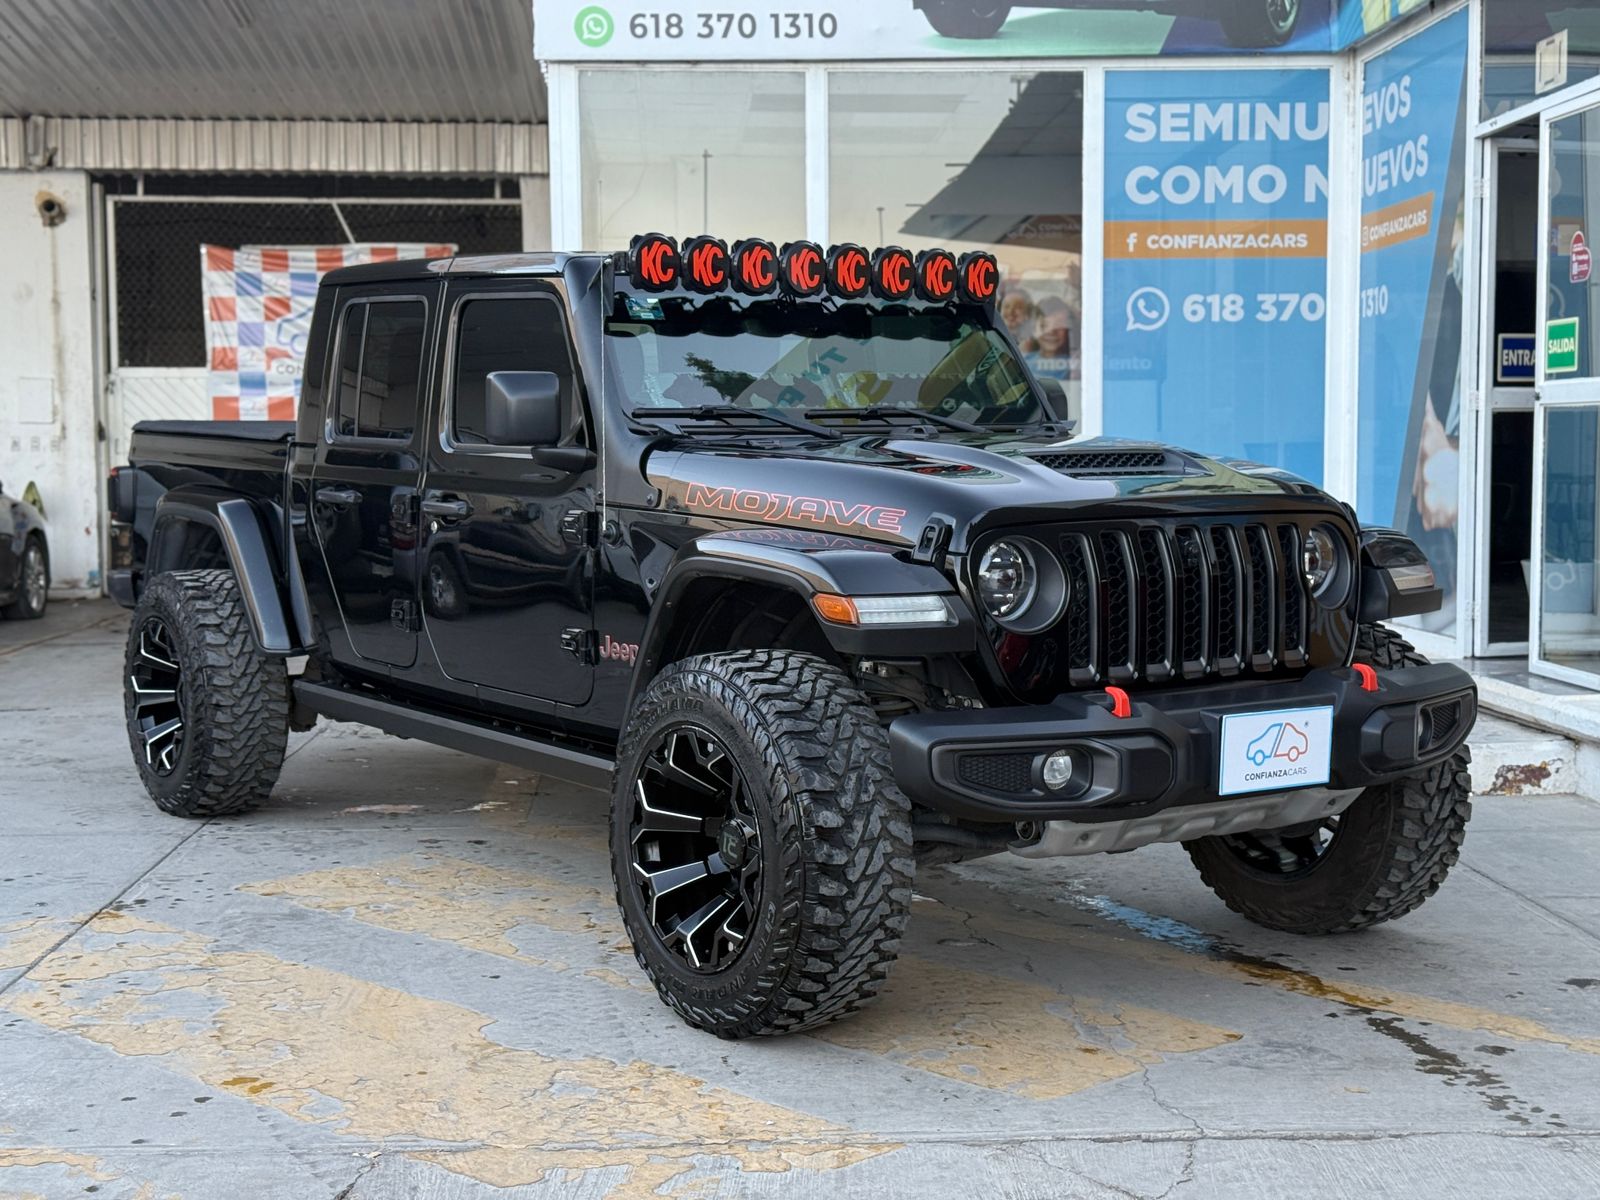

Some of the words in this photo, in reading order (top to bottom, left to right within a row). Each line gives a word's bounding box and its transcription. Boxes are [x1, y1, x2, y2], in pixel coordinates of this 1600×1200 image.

[629, 13, 684, 39] 618
[696, 13, 757, 39] 370
[769, 13, 838, 39] 1310
[1124, 102, 1329, 143] SEMINU
[1363, 75, 1412, 136] EVOS
[1125, 164, 1288, 205] COMO
[1147, 233, 1308, 249] CONFIANZACARS
[1370, 209, 1428, 241] CONFIANZACARS
[641, 241, 674, 285] KC
[693, 243, 724, 287] KC
[742, 245, 773, 288] KC
[790, 248, 820, 290] KC
[837, 250, 866, 292] KC
[882, 253, 910, 294] KC
[926, 255, 953, 296] KC
[968, 258, 995, 298] KC
[1183, 293, 1245, 322] 618
[1255, 293, 1325, 322] 370
[1361, 284, 1389, 318] 1310
[1548, 337, 1576, 354] SALIDA
[685, 481, 907, 533] MOJAVE
[599, 634, 640, 668] Jeep
[1244, 766, 1308, 781] CONFIANZACARS
